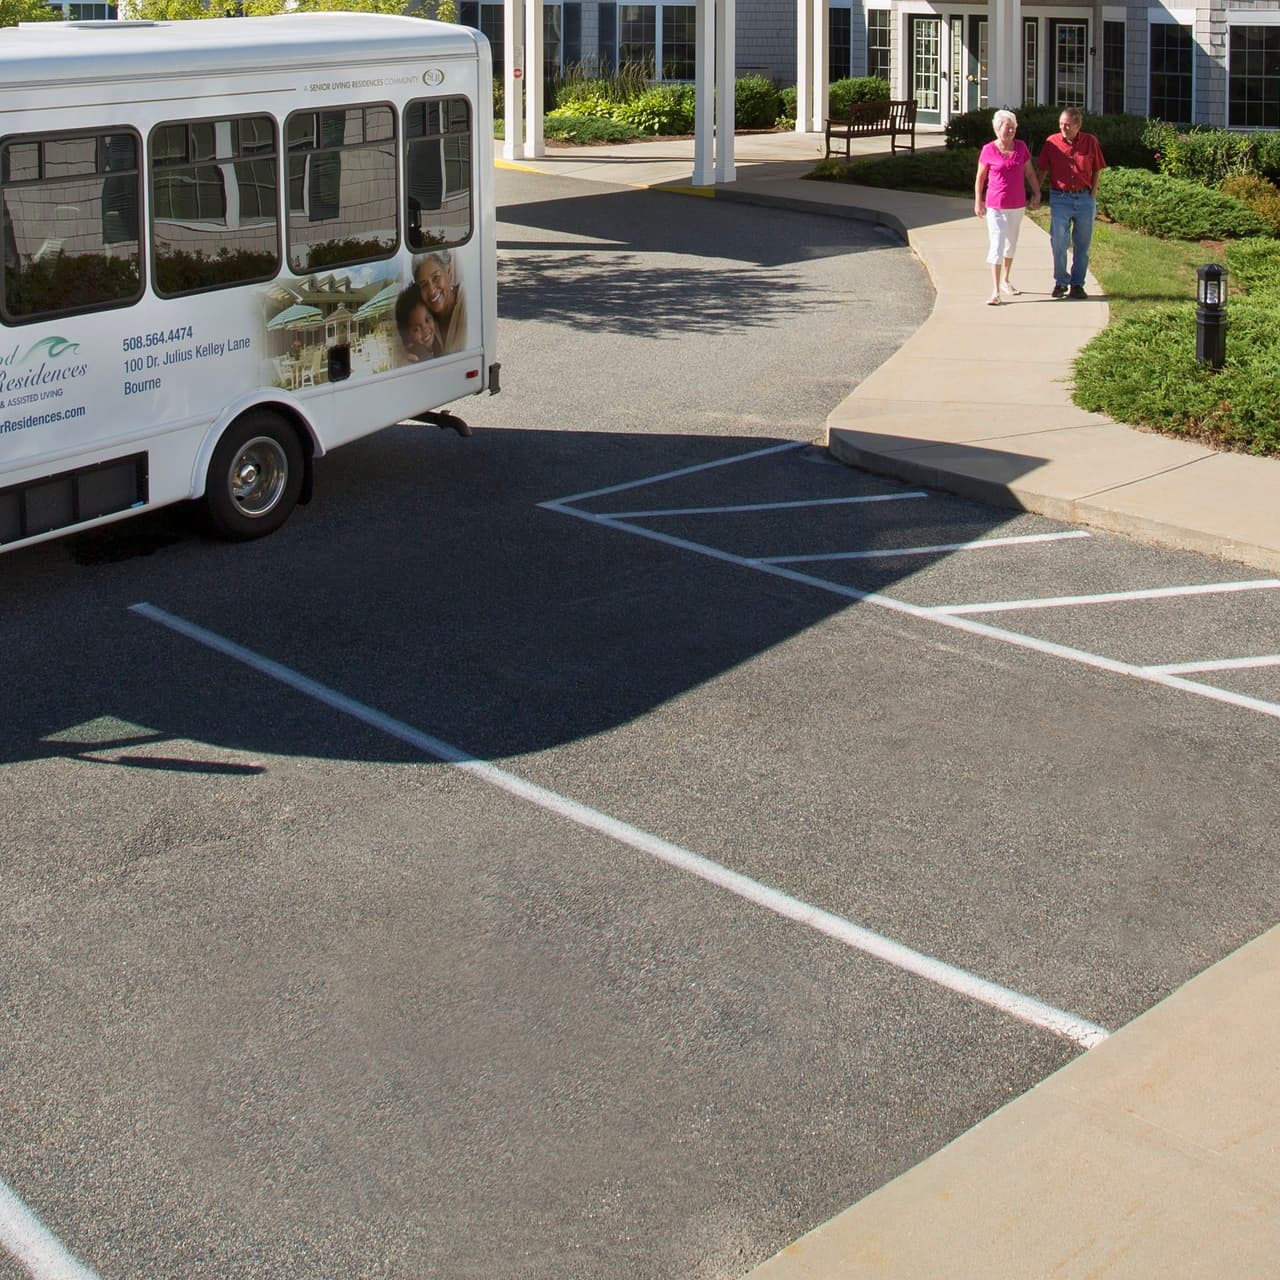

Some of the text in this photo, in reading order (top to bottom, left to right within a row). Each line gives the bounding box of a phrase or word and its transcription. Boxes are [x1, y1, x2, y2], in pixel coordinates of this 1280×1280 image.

[310, 83, 331, 92] SENIOR
[332, 81, 351, 90] LIVING
[352, 79, 384, 89] RESIDENCES
[123, 326, 193, 351] 508.564.4474
[124, 337, 251, 373] 100 Dr. Julius Kelley Lane
[124, 377, 161, 395] Bourne
[0, 400, 6, 409] &
[7, 394, 39, 407] ASSISTED
[40, 388, 64, 400] LIVING
